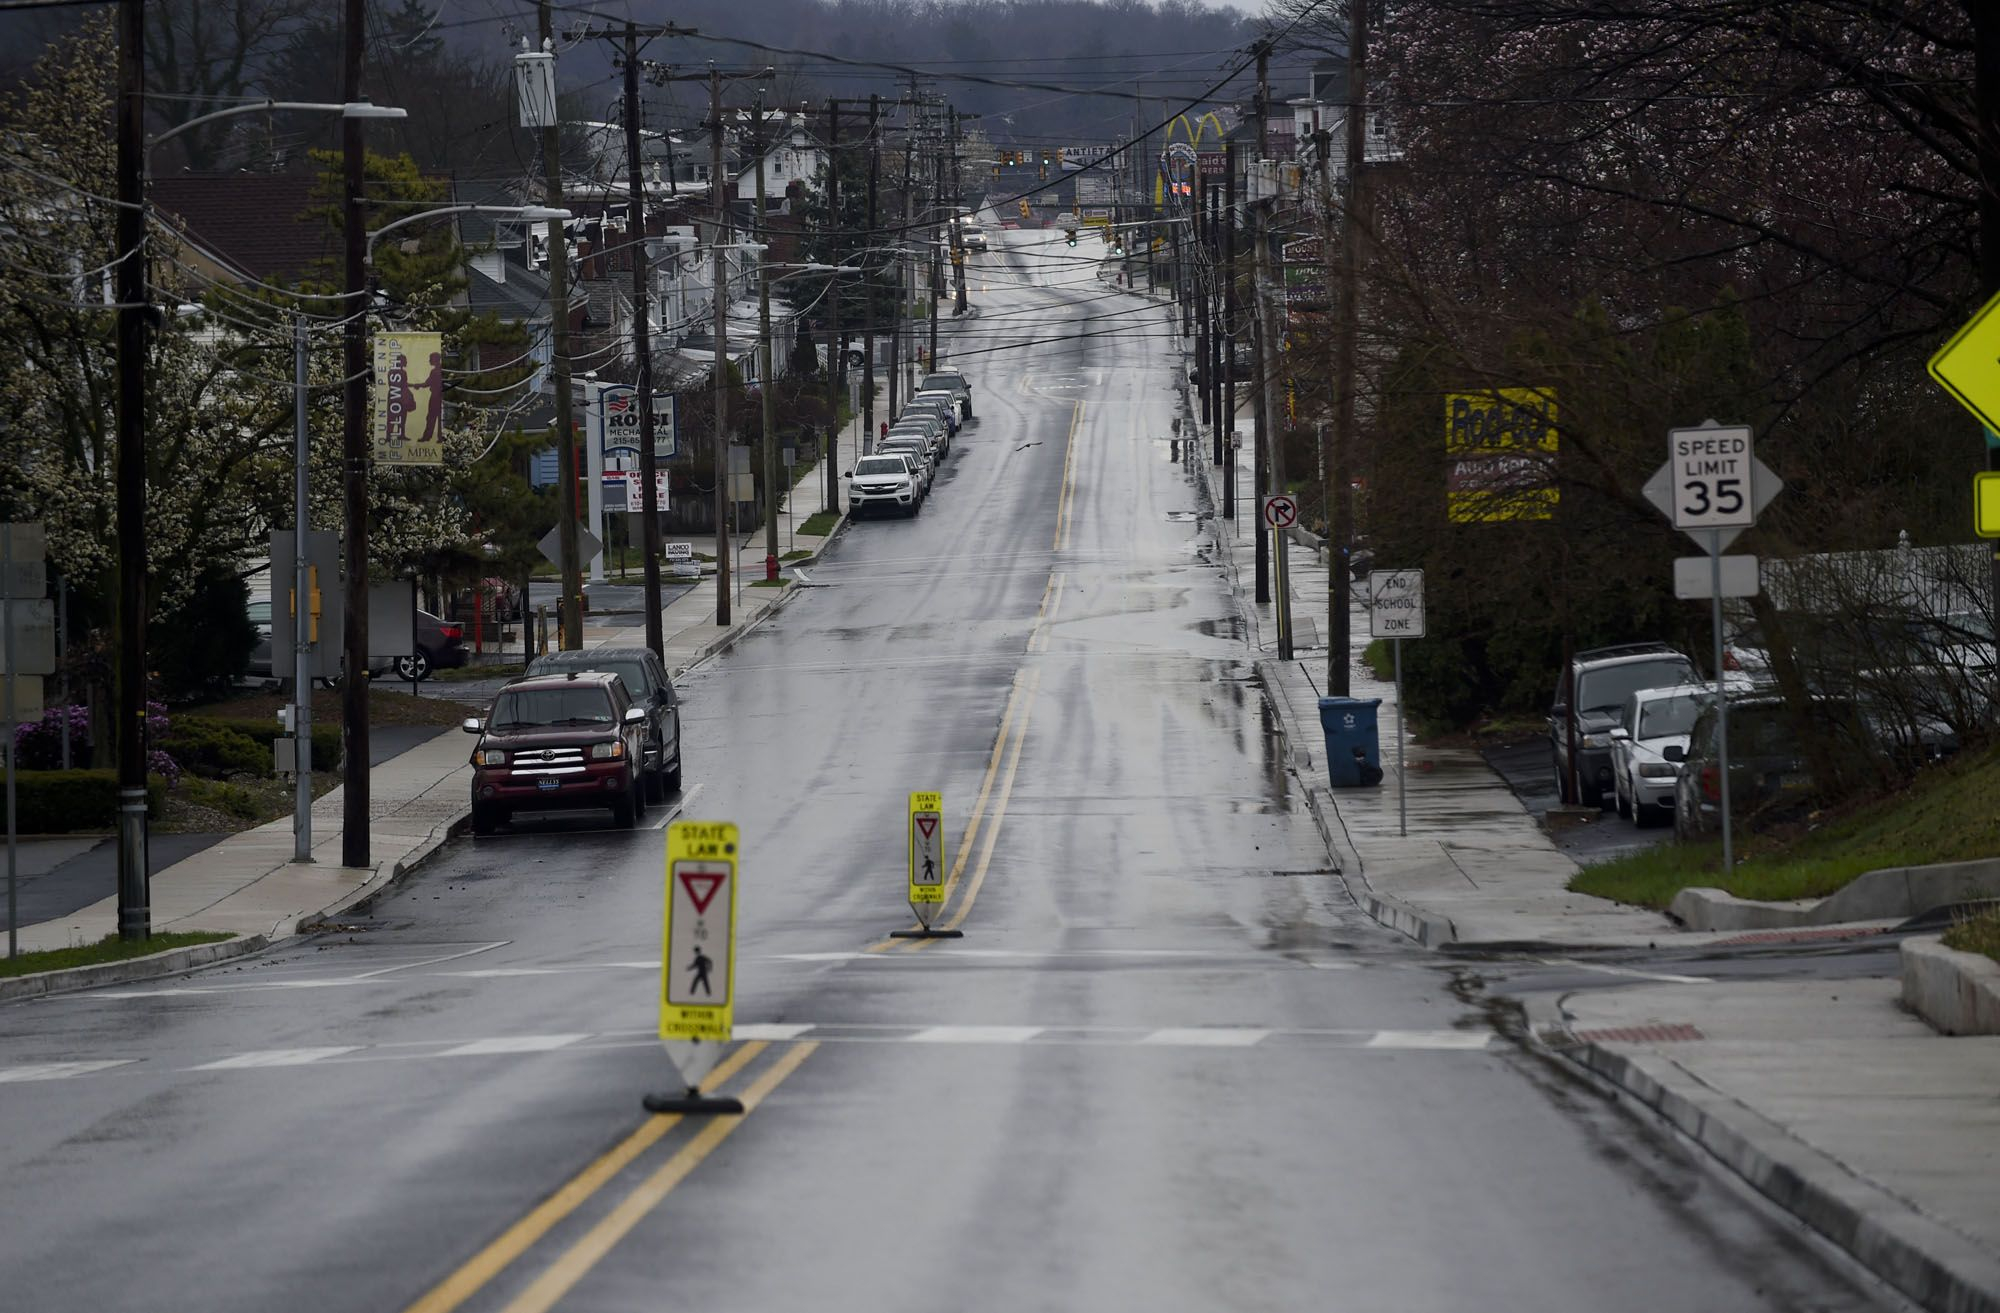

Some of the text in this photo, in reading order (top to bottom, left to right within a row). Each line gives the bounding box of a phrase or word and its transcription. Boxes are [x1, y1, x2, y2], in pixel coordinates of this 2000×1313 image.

[378, 338, 387, 459] MOUNT PENN
[389, 339, 402, 459] FELLOWSHIP
[609, 413, 669, 427] ROSI
[1678, 439, 1745, 456] SPEED
[1685, 459, 1738, 476] LIMIT
[1684, 479, 1744, 515] 35
[1386, 578, 1407, 589] END
[1377, 598, 1416, 610] SCHOOL
[1384, 619, 1410, 630] ZONE
[916, 794, 937, 802] STATE
[681, 825, 727, 842] STATE
[687, 843, 718, 858] LAW
